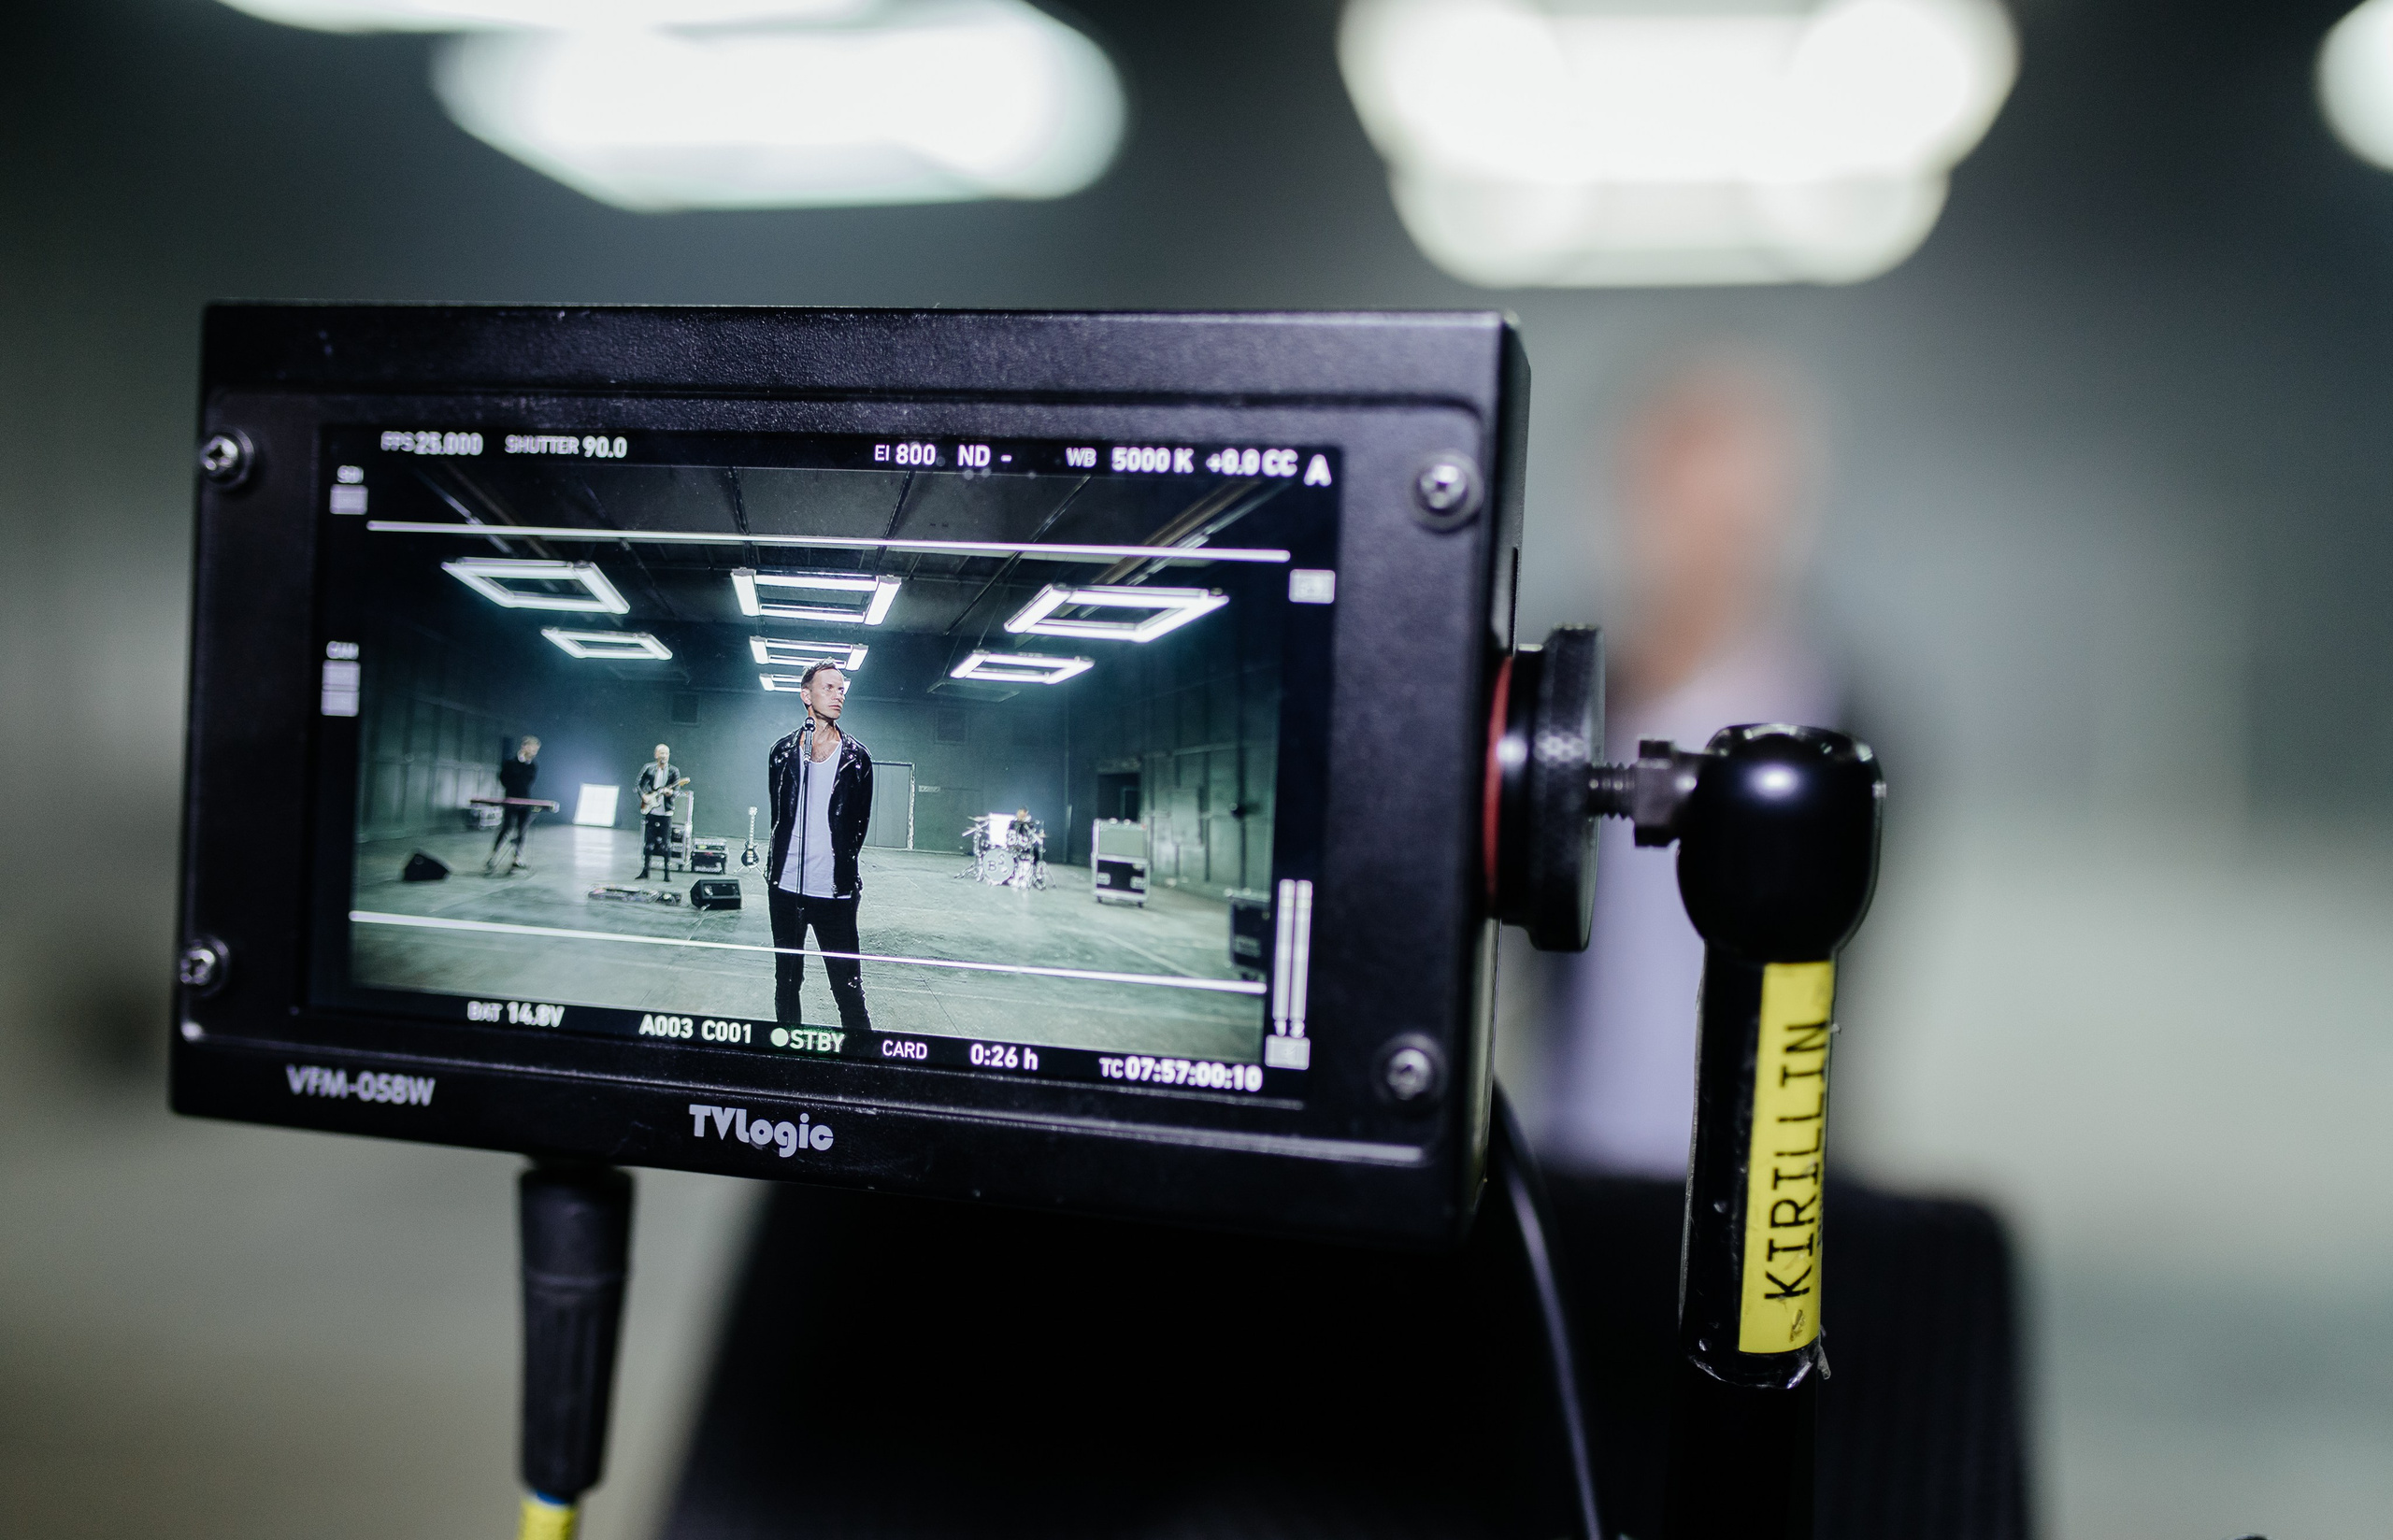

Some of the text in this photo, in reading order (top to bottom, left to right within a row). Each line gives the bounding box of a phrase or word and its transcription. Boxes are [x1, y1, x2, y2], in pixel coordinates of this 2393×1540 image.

[414, 431, 483, 455] 25.000
[505, 435, 627, 458] SHUTTER 90.0
[895, 443, 936, 465] 800
[957, 444, 991, 467] ND
[1066, 447, 1194, 474] WB 5000 K
[1262, 449, 1298, 478] CC
[1303, 454, 1332, 487] A
[638, 1014, 752, 1045] A003 C001
[789, 1031, 845, 1054] STBY
[881, 1040, 928, 1060] CARD
[970, 1043, 1039, 1071] 0:26 h
[1099, 1056, 1264, 1092] TC 07:57:00:10
[1764, 1020, 1828, 1300] KIRILLIN
